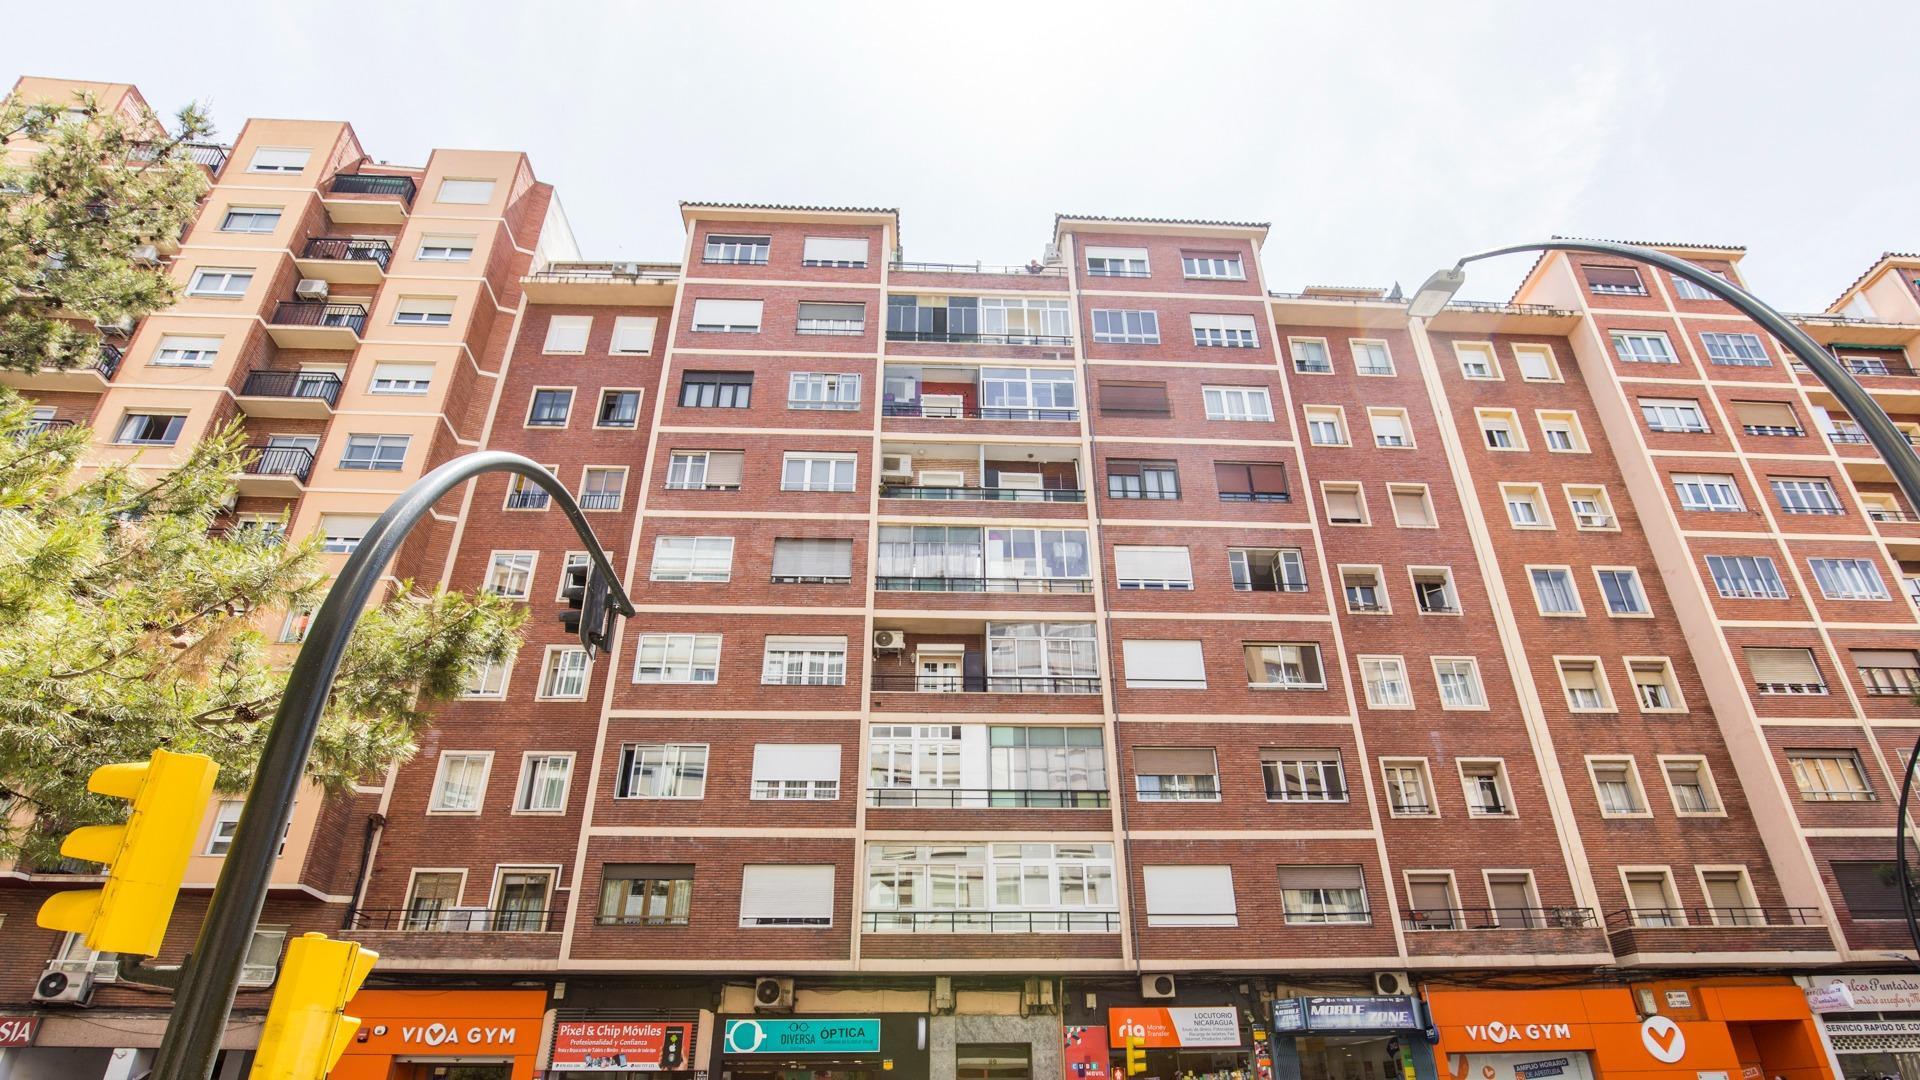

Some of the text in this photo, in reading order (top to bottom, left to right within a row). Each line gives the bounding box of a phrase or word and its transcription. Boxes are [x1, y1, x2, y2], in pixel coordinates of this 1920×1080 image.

[1869, 978, 1919, 991] Puntadas
[1311, 1004, 1365, 1016] MOBILE
[1366, 1011, 1409, 1022] ZONE
[0, 1021, 31, 1042] SIA
[560, 1024, 662, 1038] Pixel & Chip Móviles
[1118, 1018, 1146, 1037] ria
[1146, 1024, 1167, 1032] Money
[1465, 1021, 1571, 1043] VIVA GYM
[1825, 1024, 1863, 1032] SERVICIO
[1864, 1023, 1894, 1031] RAPIDO
[1895, 1023, 1906, 1031] DE
[402, 1023, 516, 1046] VIVA GYM
[780, 1027, 865, 1045] DIVERSA ÓPTICA
[1540, 1059, 1567, 1068] HORARIO
